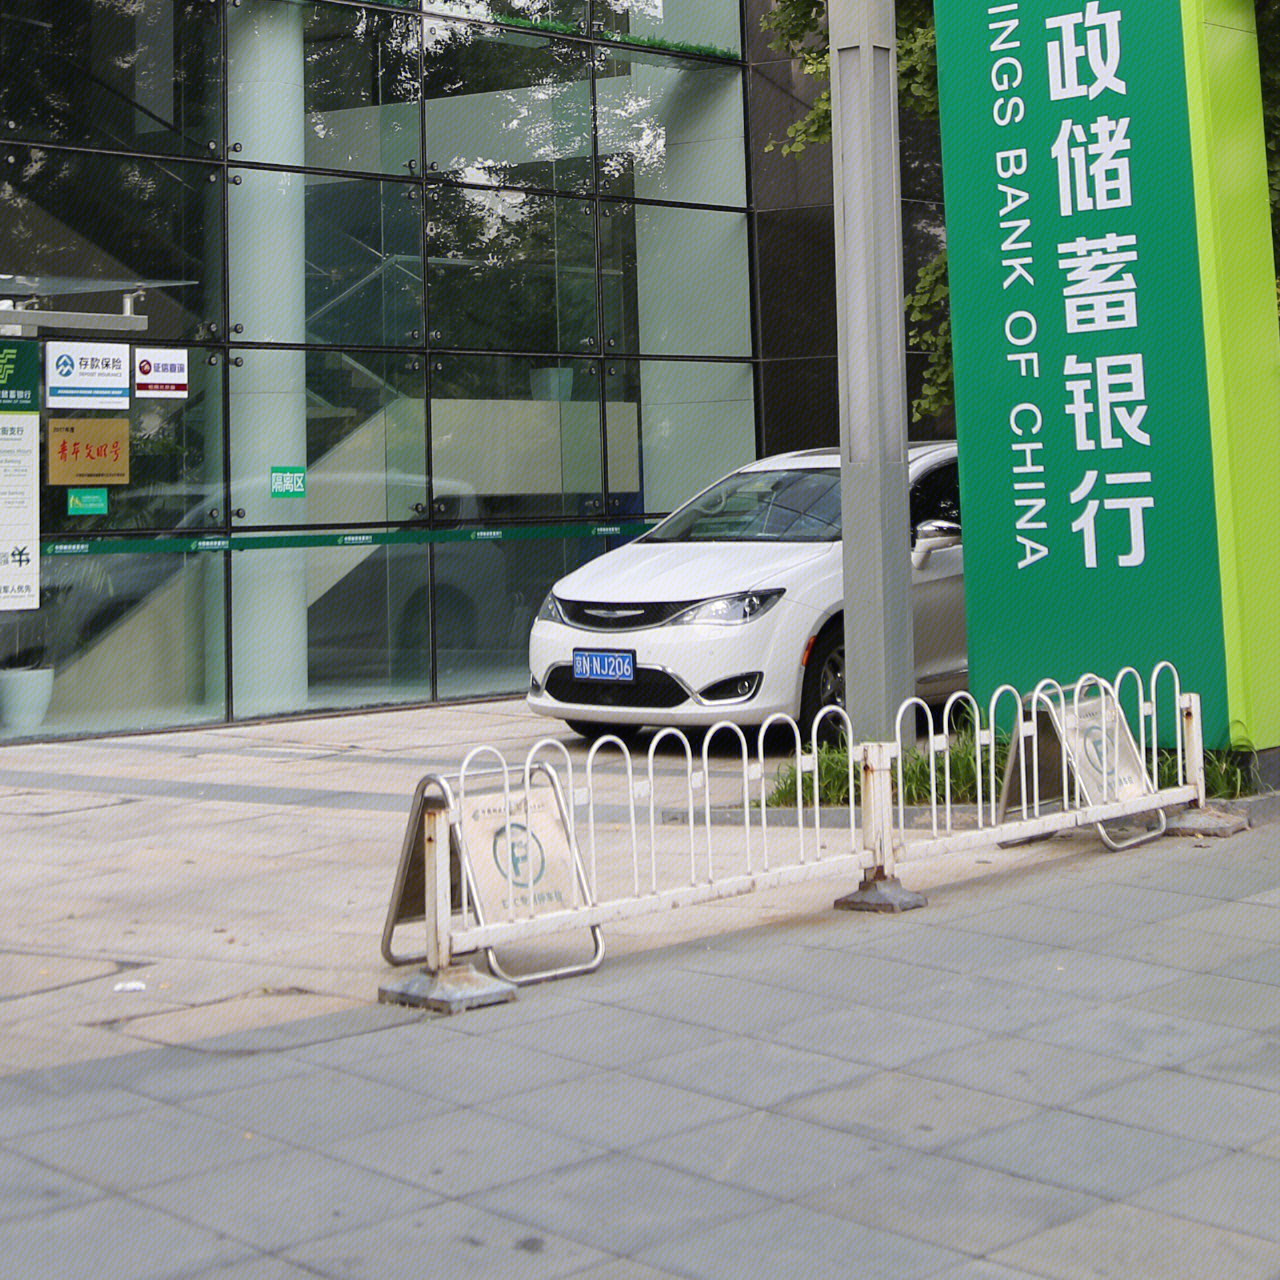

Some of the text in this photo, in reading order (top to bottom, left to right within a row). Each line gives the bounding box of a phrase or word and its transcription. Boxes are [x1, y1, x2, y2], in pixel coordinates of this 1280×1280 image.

[995, 148, 1035, 291] BANK
[79, 357, 122, 370] 存款保险
[1004, 310, 1040, 379] OF
[58, 440, 120, 462] 青年文明号
[271, 472, 304, 493] 隔离区
[1009, 402, 1050, 570] CHINA
